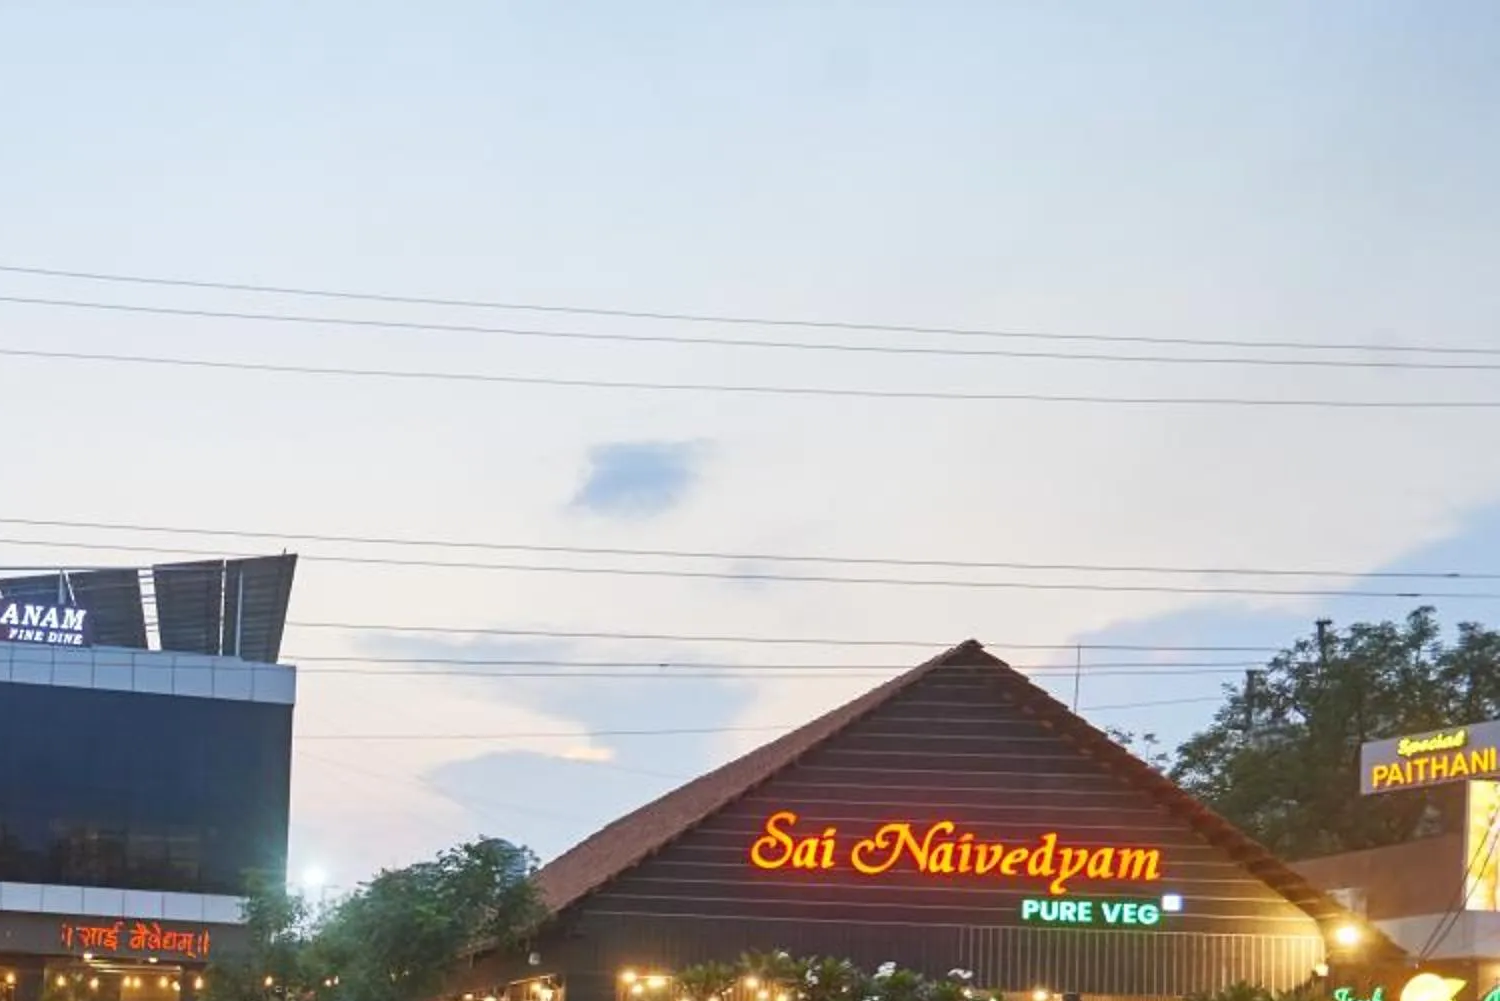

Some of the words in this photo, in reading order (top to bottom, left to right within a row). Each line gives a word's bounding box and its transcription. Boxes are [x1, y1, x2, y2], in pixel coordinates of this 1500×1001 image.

[8, 628, 45, 642] FINE
[47, 631, 84, 645] DINE
[1371, 746, 1497, 789] PAITHANI
[750, 810, 838, 870] Sai
[850, 820, 1162, 896] Naivedyam
[1021, 898, 1093, 922] PURE
[1101, 901, 1161, 925] VEG
